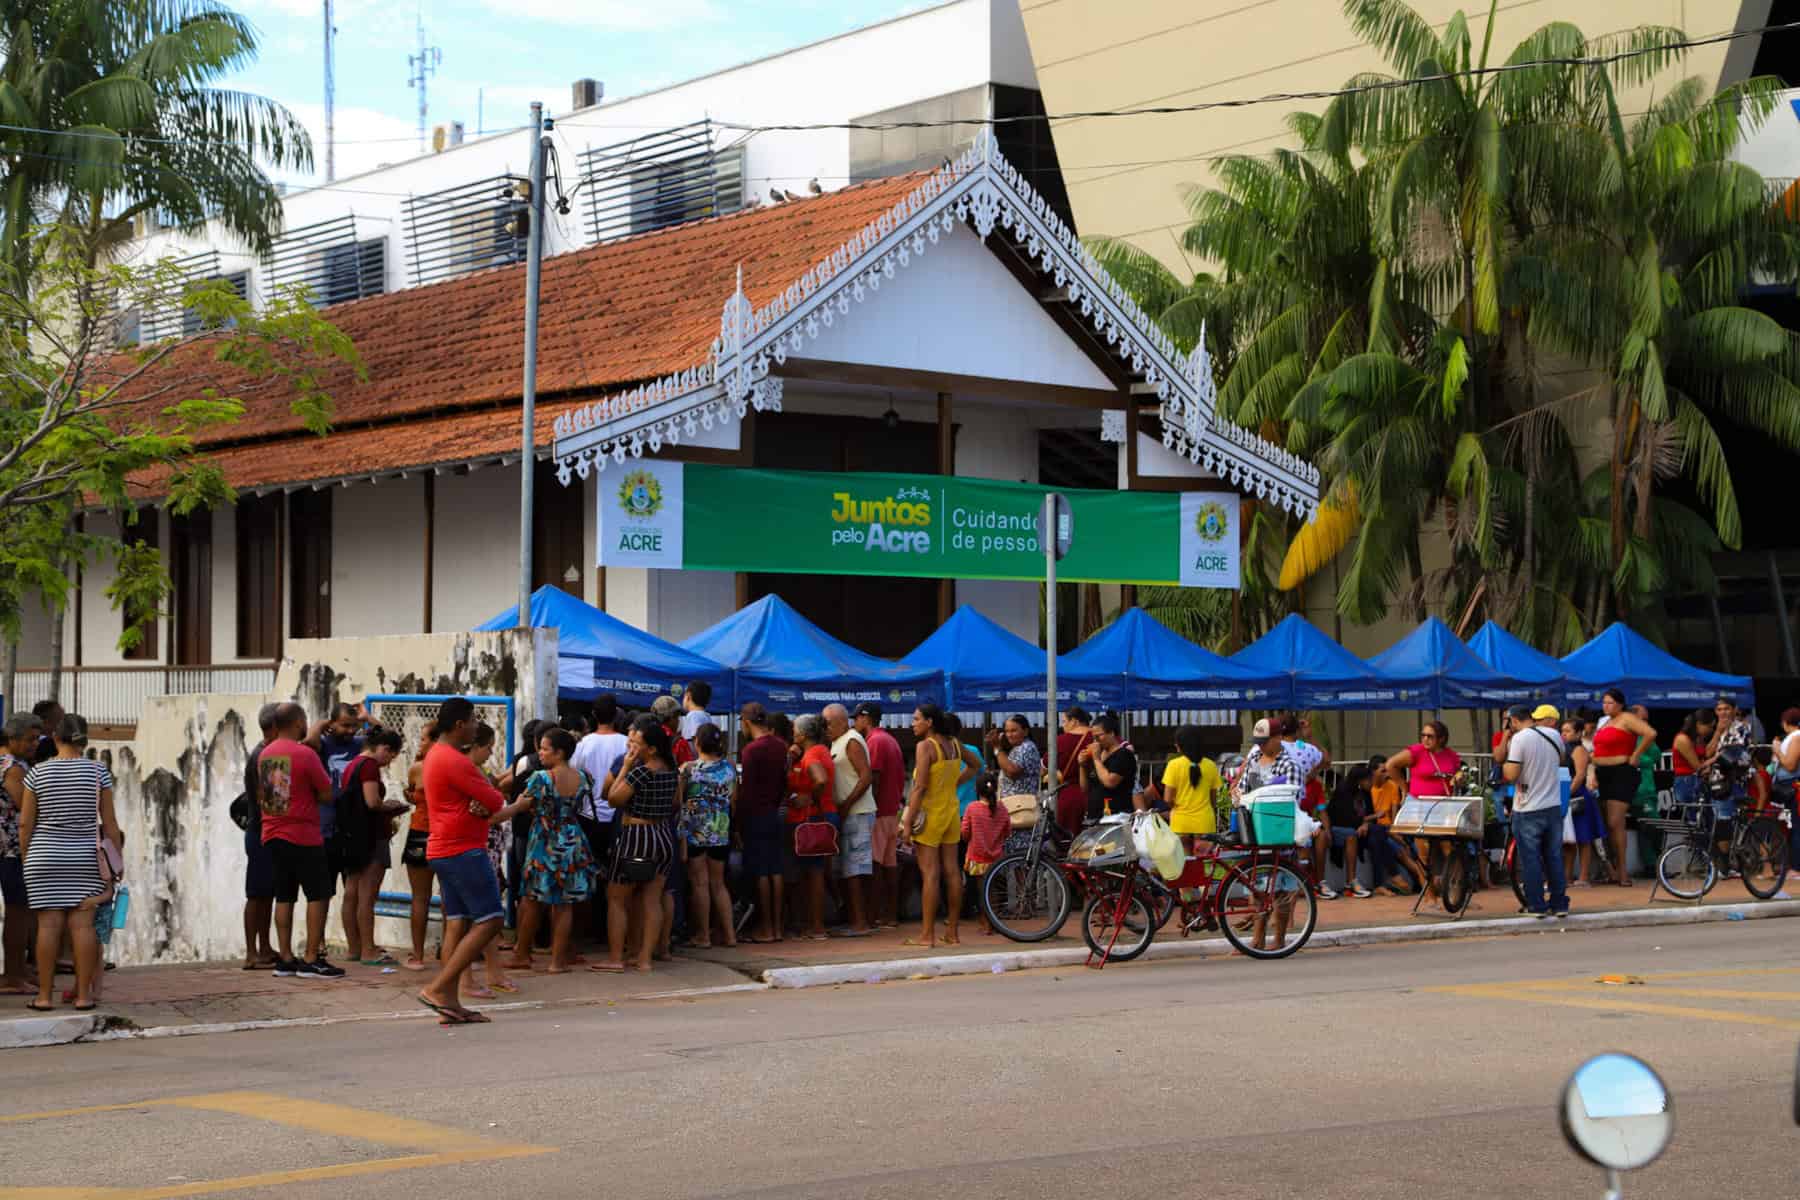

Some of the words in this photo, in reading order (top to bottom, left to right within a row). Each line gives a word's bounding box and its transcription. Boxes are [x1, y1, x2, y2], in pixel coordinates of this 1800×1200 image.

[831, 492, 931, 527] Juntos
[619, 534, 662, 551] ACRE
[831, 528, 865, 545] pelo
[864, 523, 931, 553] Acre
[952, 532, 975, 549] de
[982, 536, 1040, 554] pesso
[1195, 555, 1229, 571] ACRE
